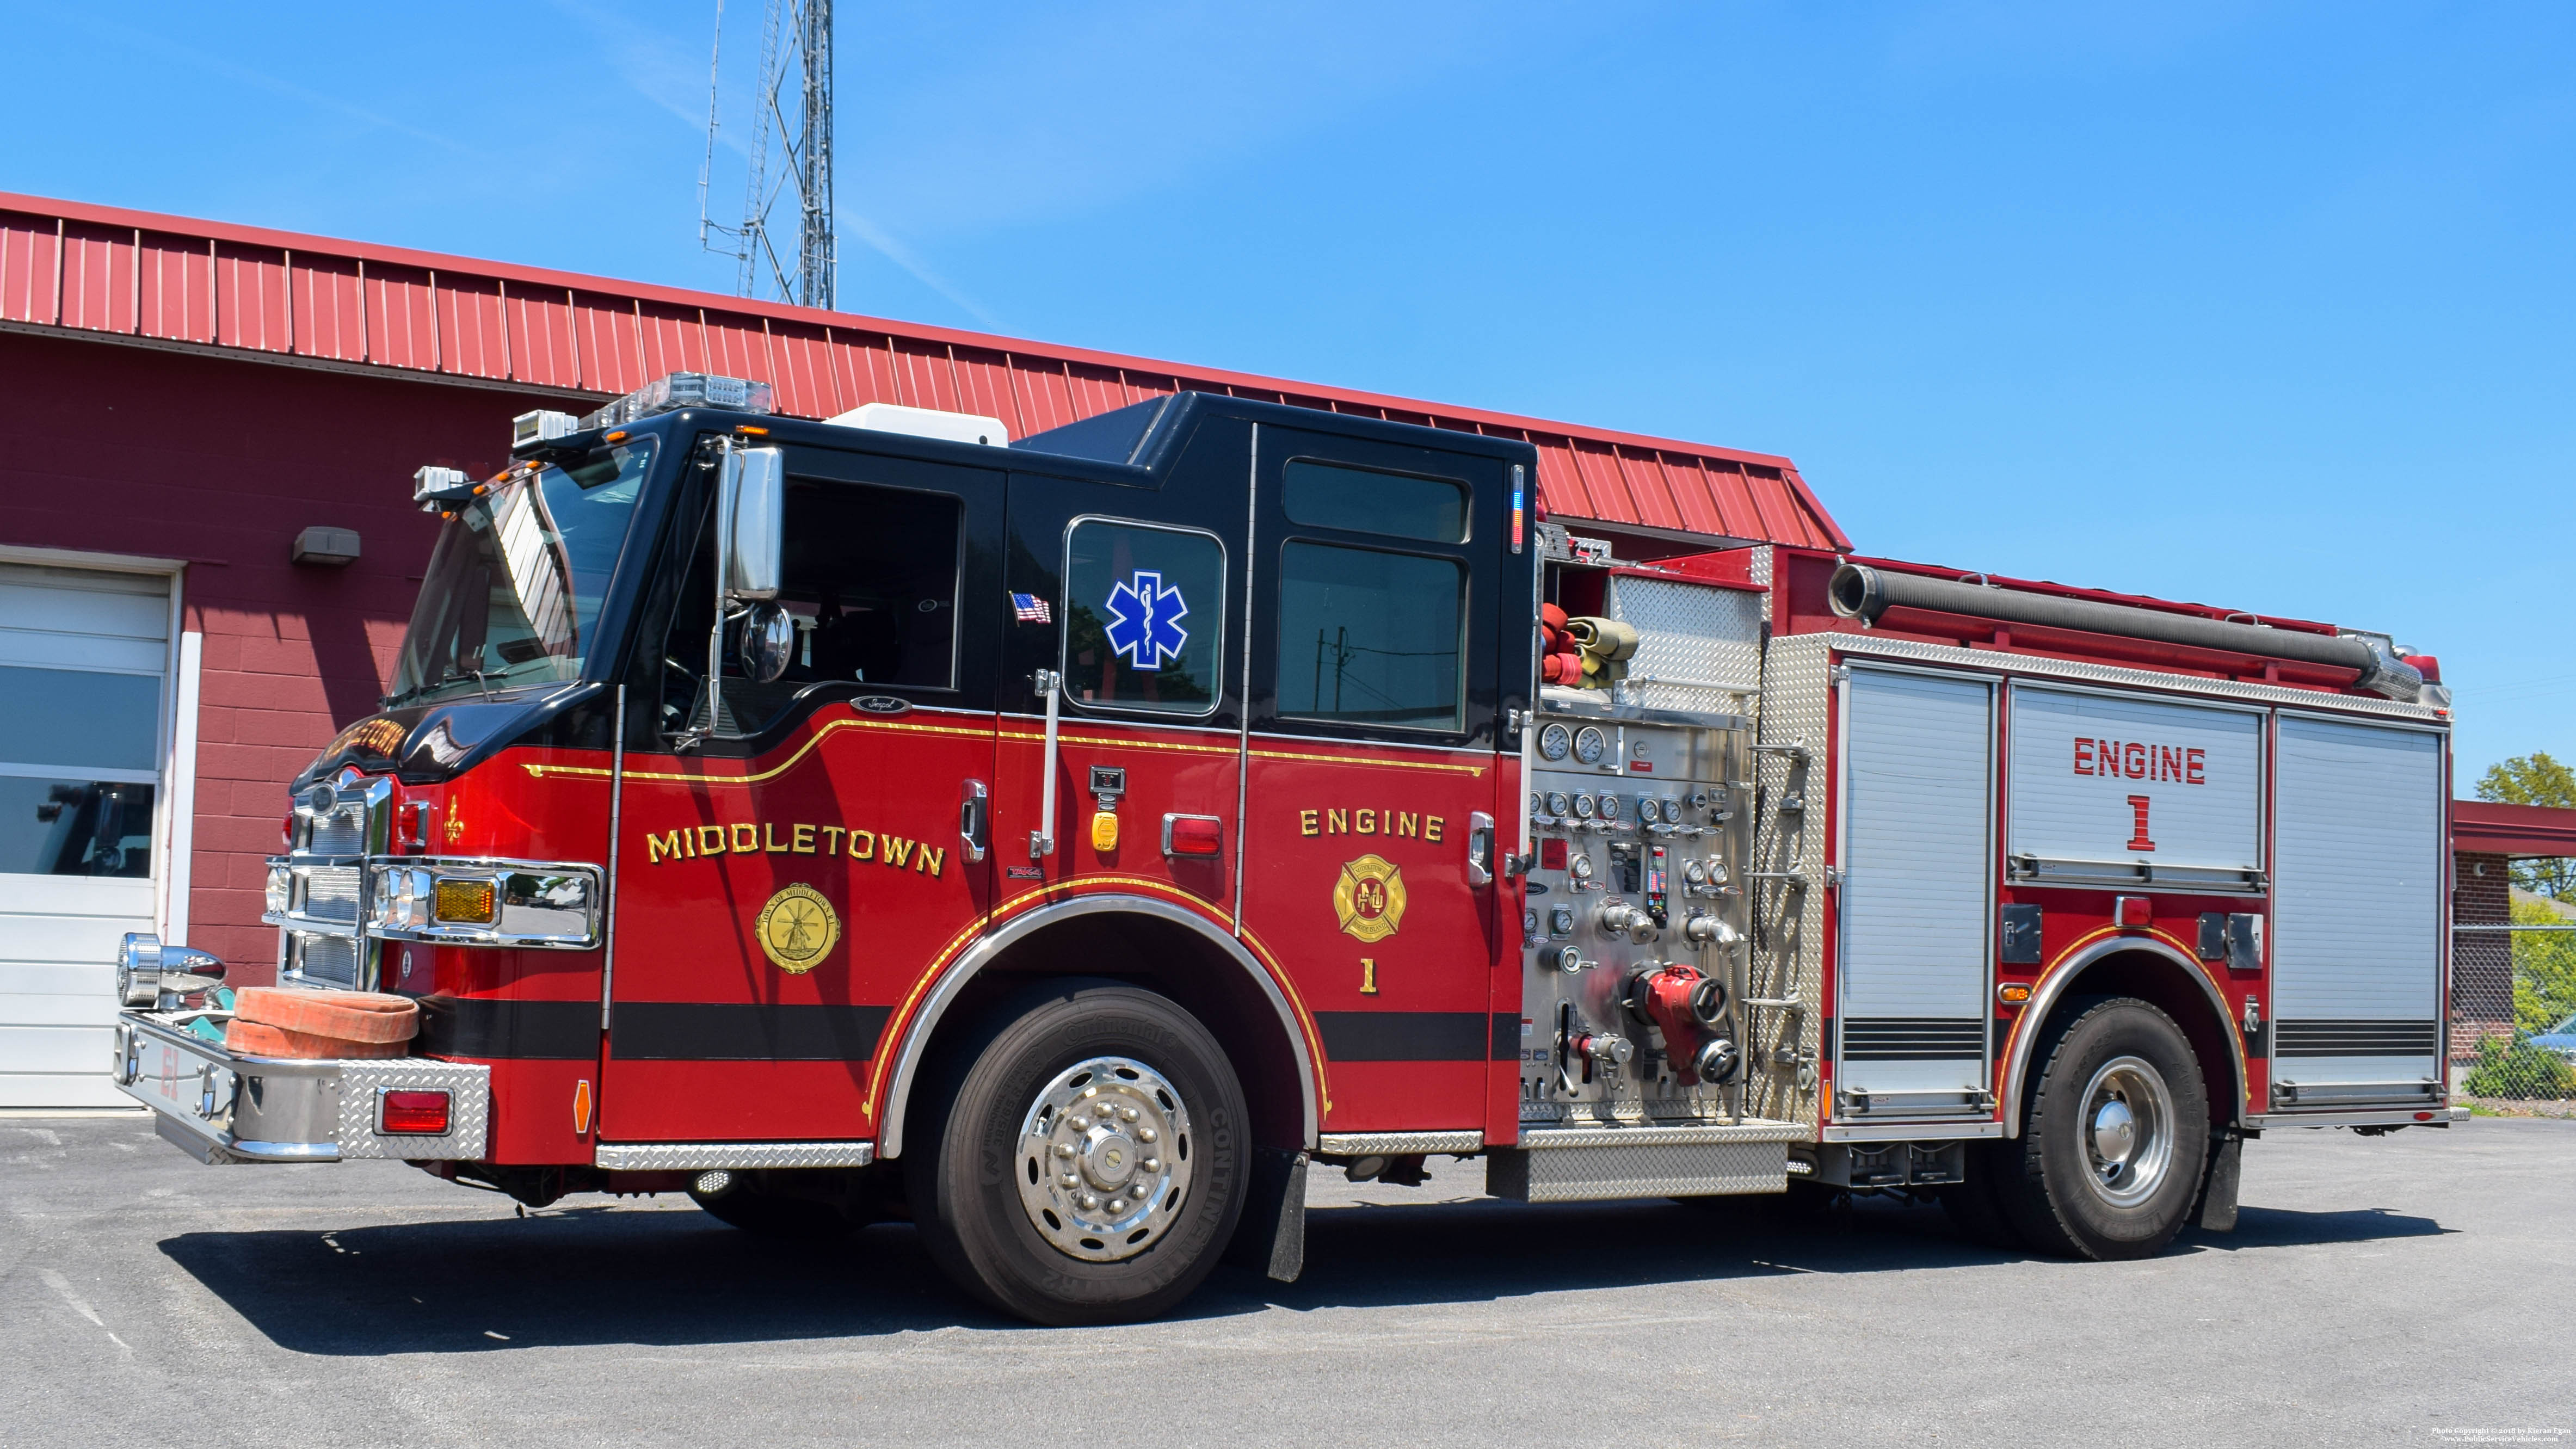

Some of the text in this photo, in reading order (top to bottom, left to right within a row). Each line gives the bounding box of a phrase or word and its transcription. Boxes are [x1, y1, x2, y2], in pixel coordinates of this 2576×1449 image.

[2074, 737, 2205, 785] ENGINE
[1300, 809, 1444, 841] ENGINE
[2127, 794, 2155, 852] 1
[646, 823, 944, 876] MIDDLETOWN
[775, 895, 785, 904] OF
[786, 889, 829, 913] MIDDLETOWN
[1359, 958, 1377, 992] 1
